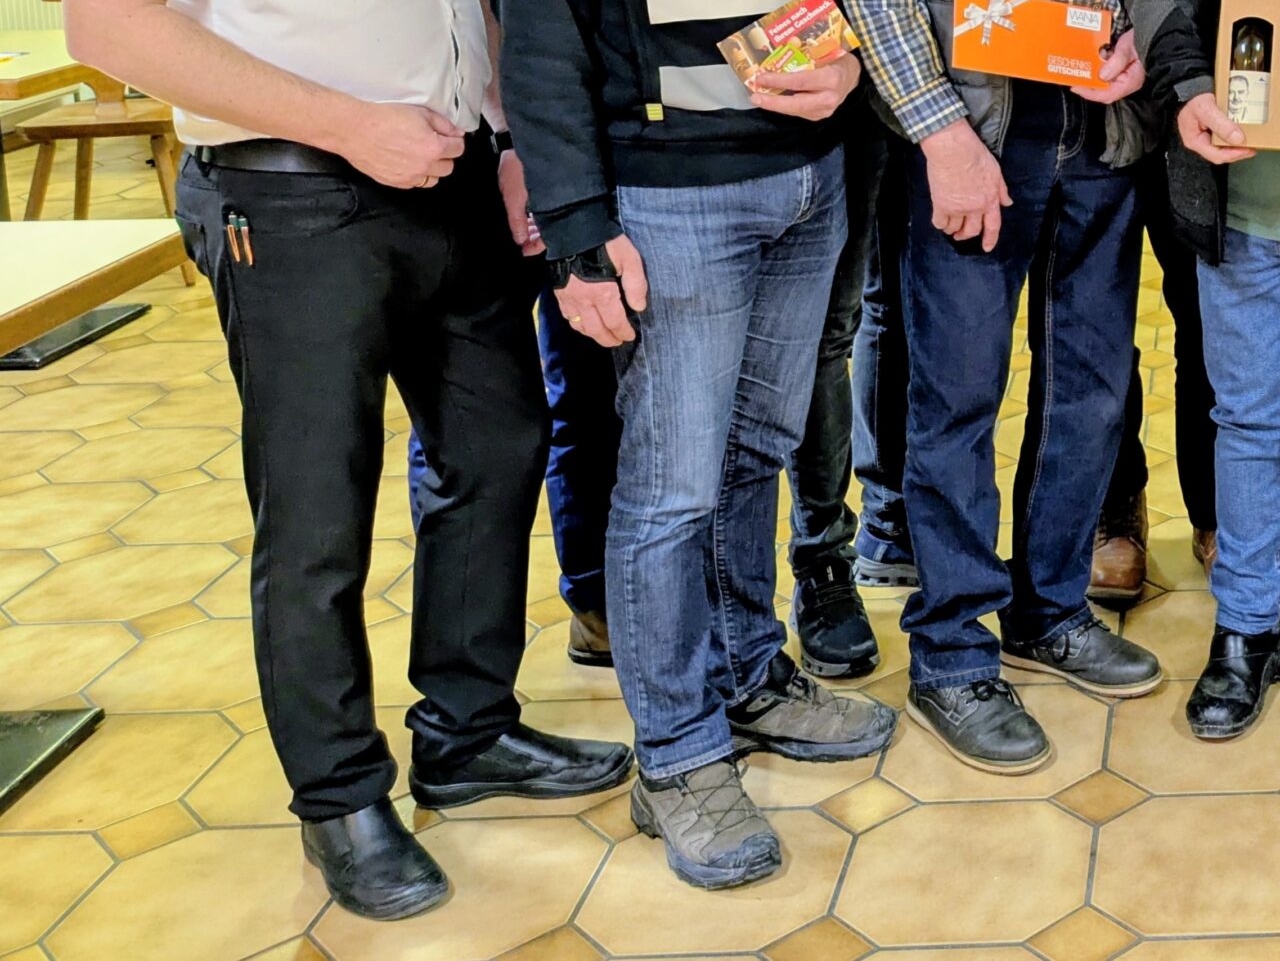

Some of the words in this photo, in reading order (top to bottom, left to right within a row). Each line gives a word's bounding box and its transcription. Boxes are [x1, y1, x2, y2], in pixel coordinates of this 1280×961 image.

[768, 19, 791, 36] Feines
[790, 6, 808, 22] nach
[773, 25, 796, 43] Ihrem
[794, 0, 832, 29] Geschmack.
[1047, 55, 1092, 71] GESCHENKS
[1047, 64, 1093, 79] GUTSCHEINE
